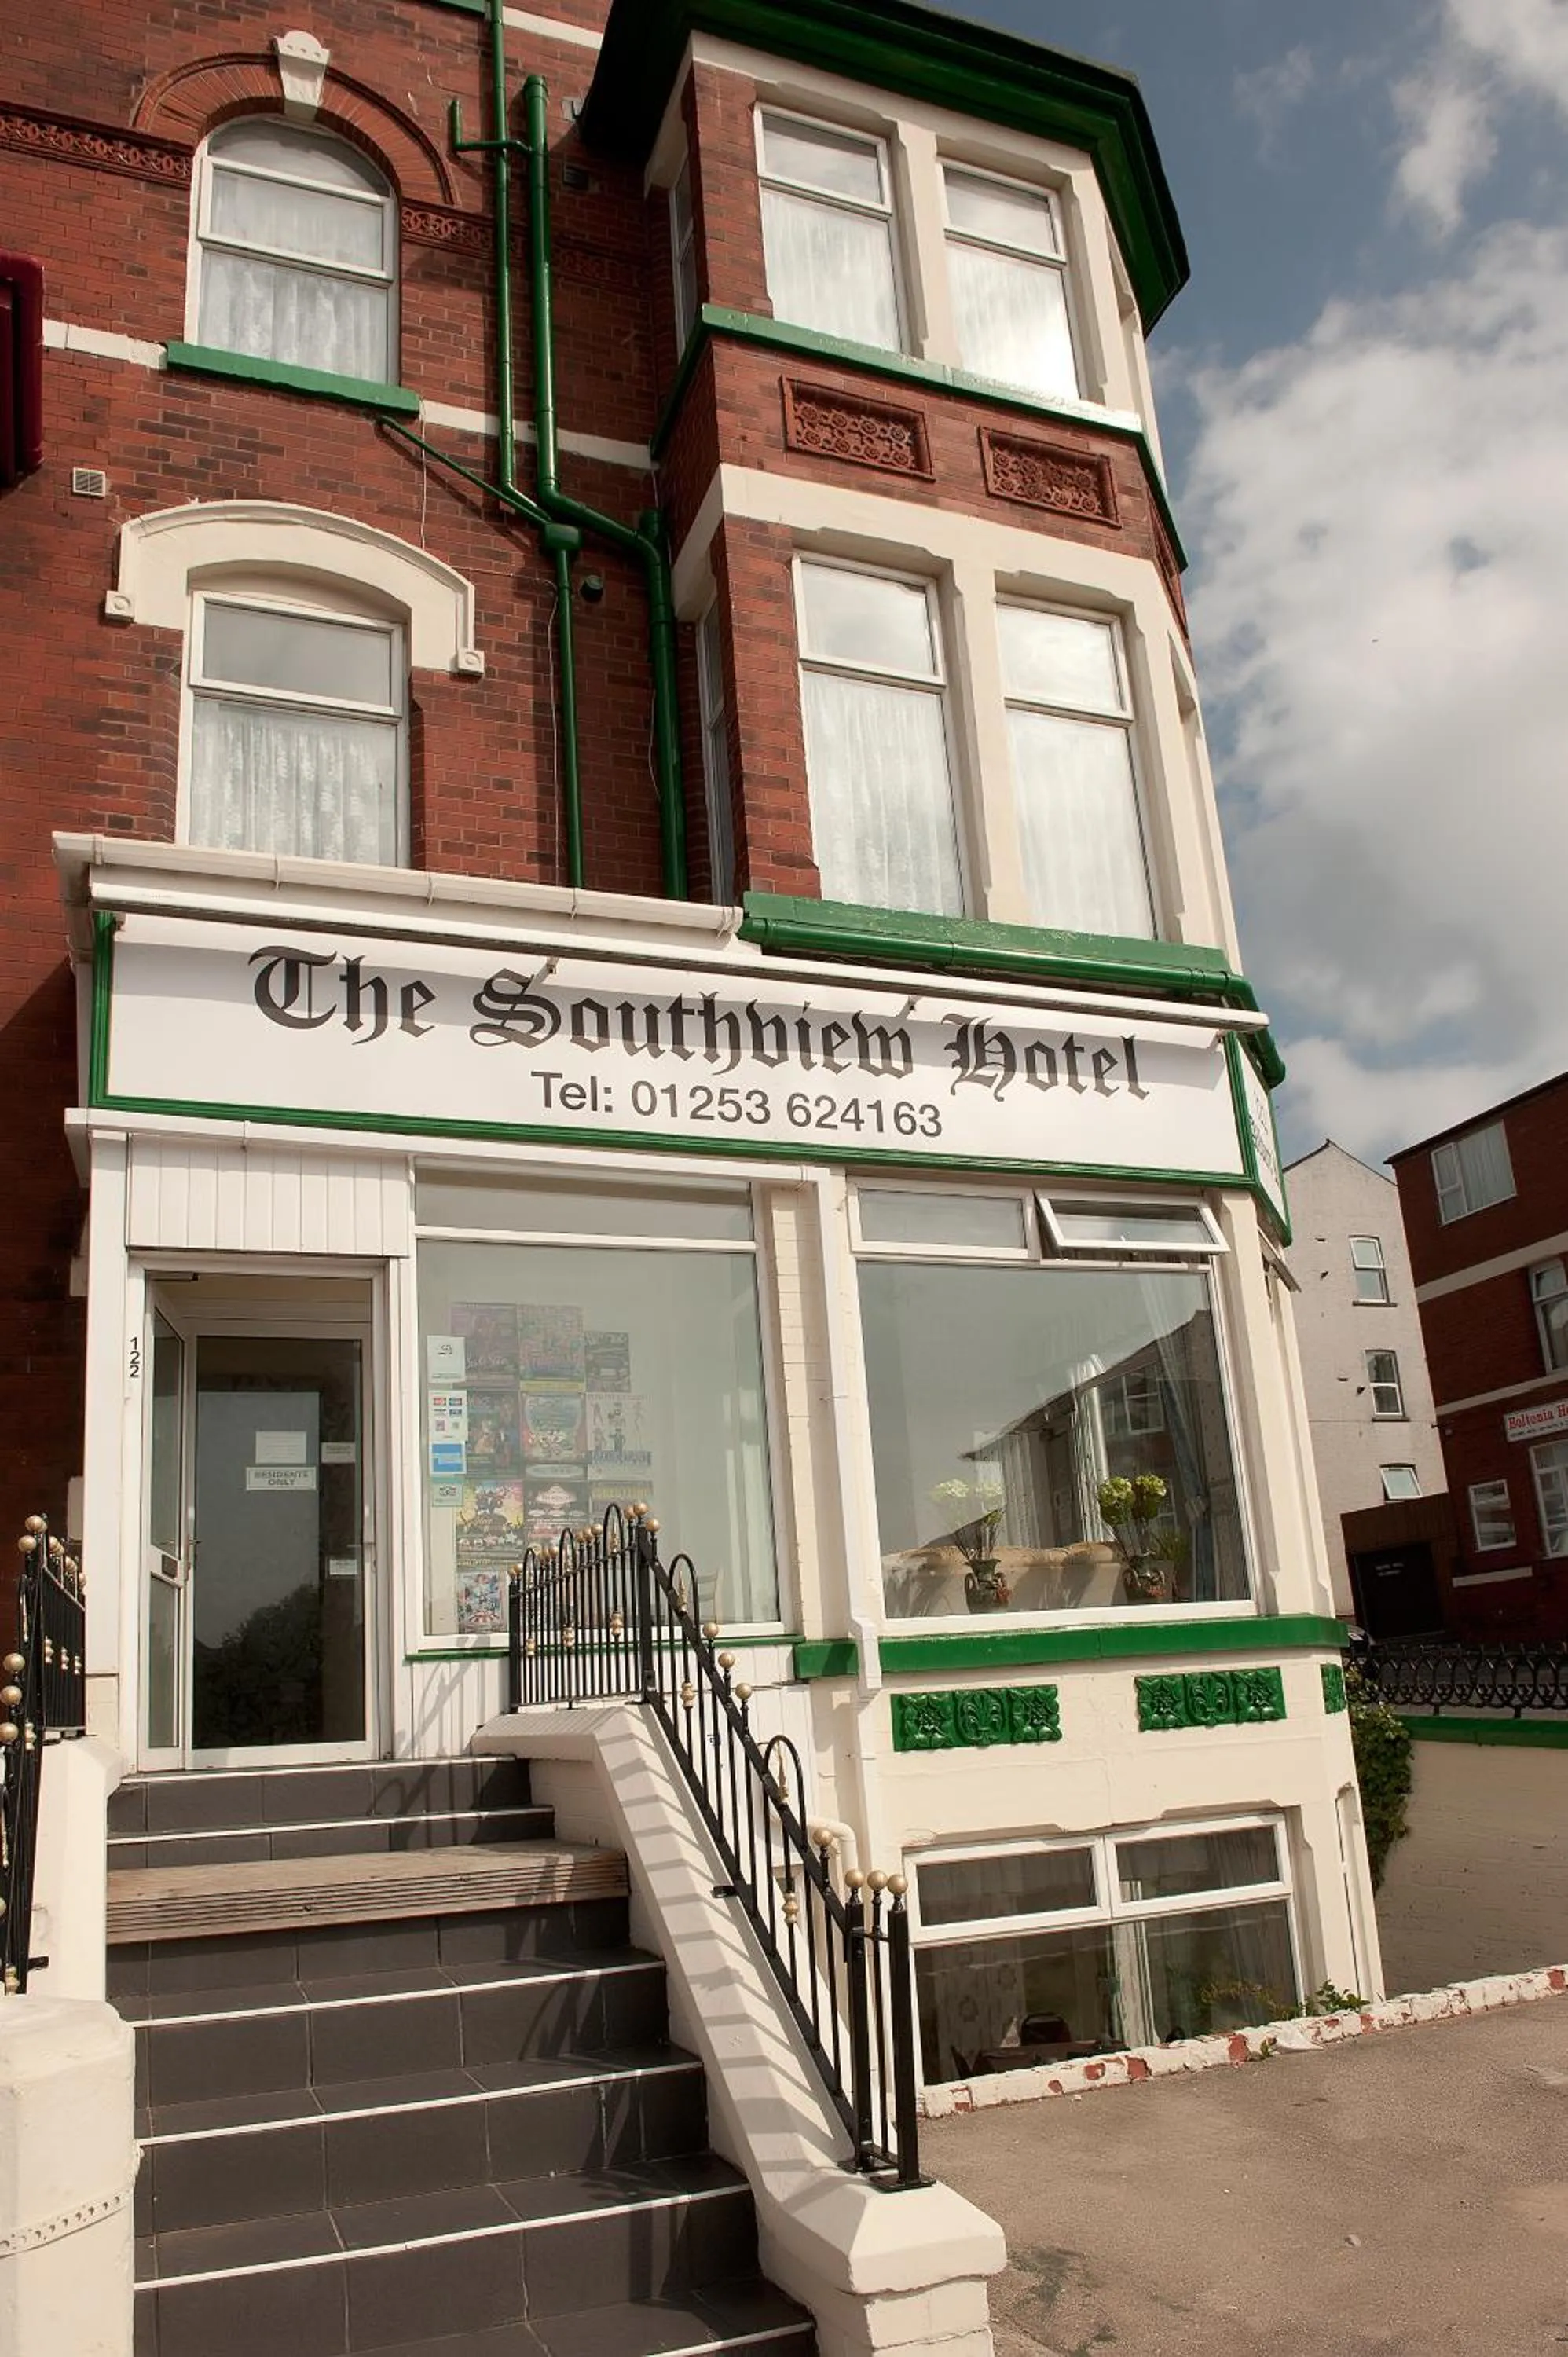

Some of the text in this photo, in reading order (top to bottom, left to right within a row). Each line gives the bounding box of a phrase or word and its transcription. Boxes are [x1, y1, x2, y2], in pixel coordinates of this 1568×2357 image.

[247, 944, 1149, 1102] The Southview Hotel
[531, 1071, 943, 1138] Tel: 01253 624163
[130, 1336, 140, 1377] 122
